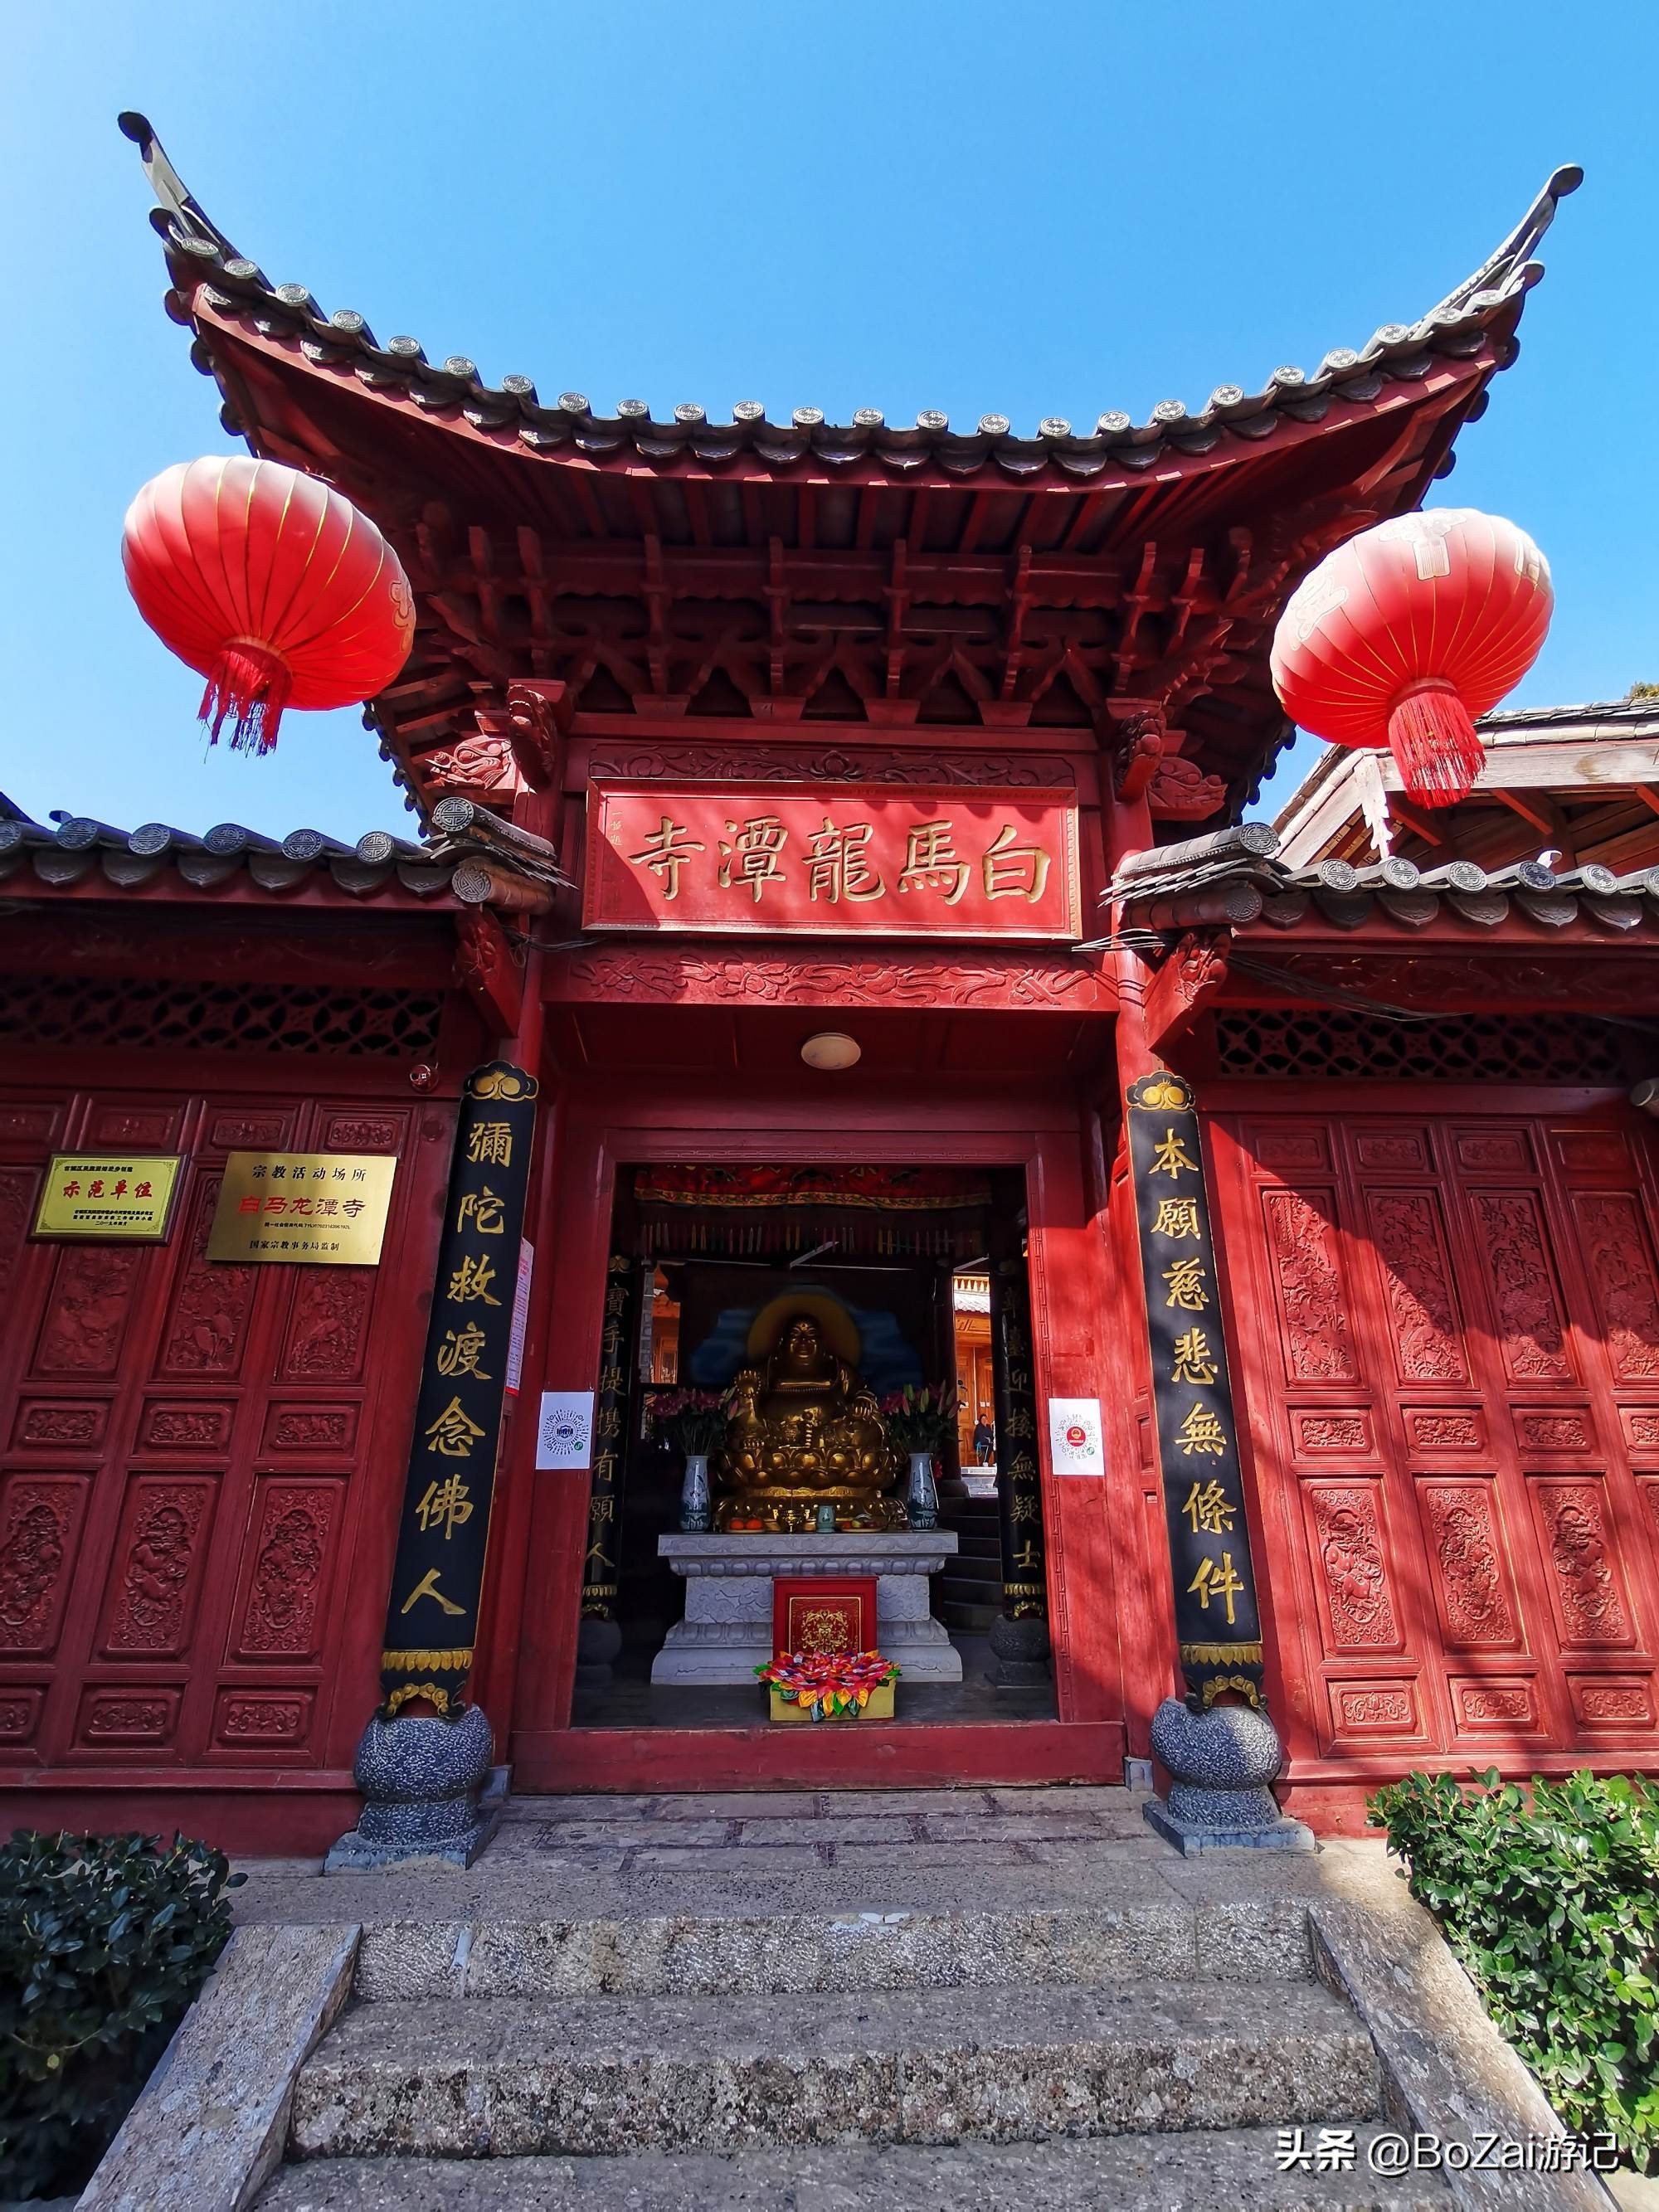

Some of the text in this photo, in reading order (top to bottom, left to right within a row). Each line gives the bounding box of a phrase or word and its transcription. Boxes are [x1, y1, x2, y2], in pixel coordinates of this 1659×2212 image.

[251, 1164, 368, 1183] 宗教活动场所
[63, 1179, 153, 1201] 示范单位
[237, 1194, 367, 1217] 白马龙潭寺
[249, 1240, 340, 1252] 国家宗教事务局监制
[401, 1121, 512, 1616] 彌陀救渡念佛人
[1149, 1128, 1244, 1626] 本願慈悲無條件
